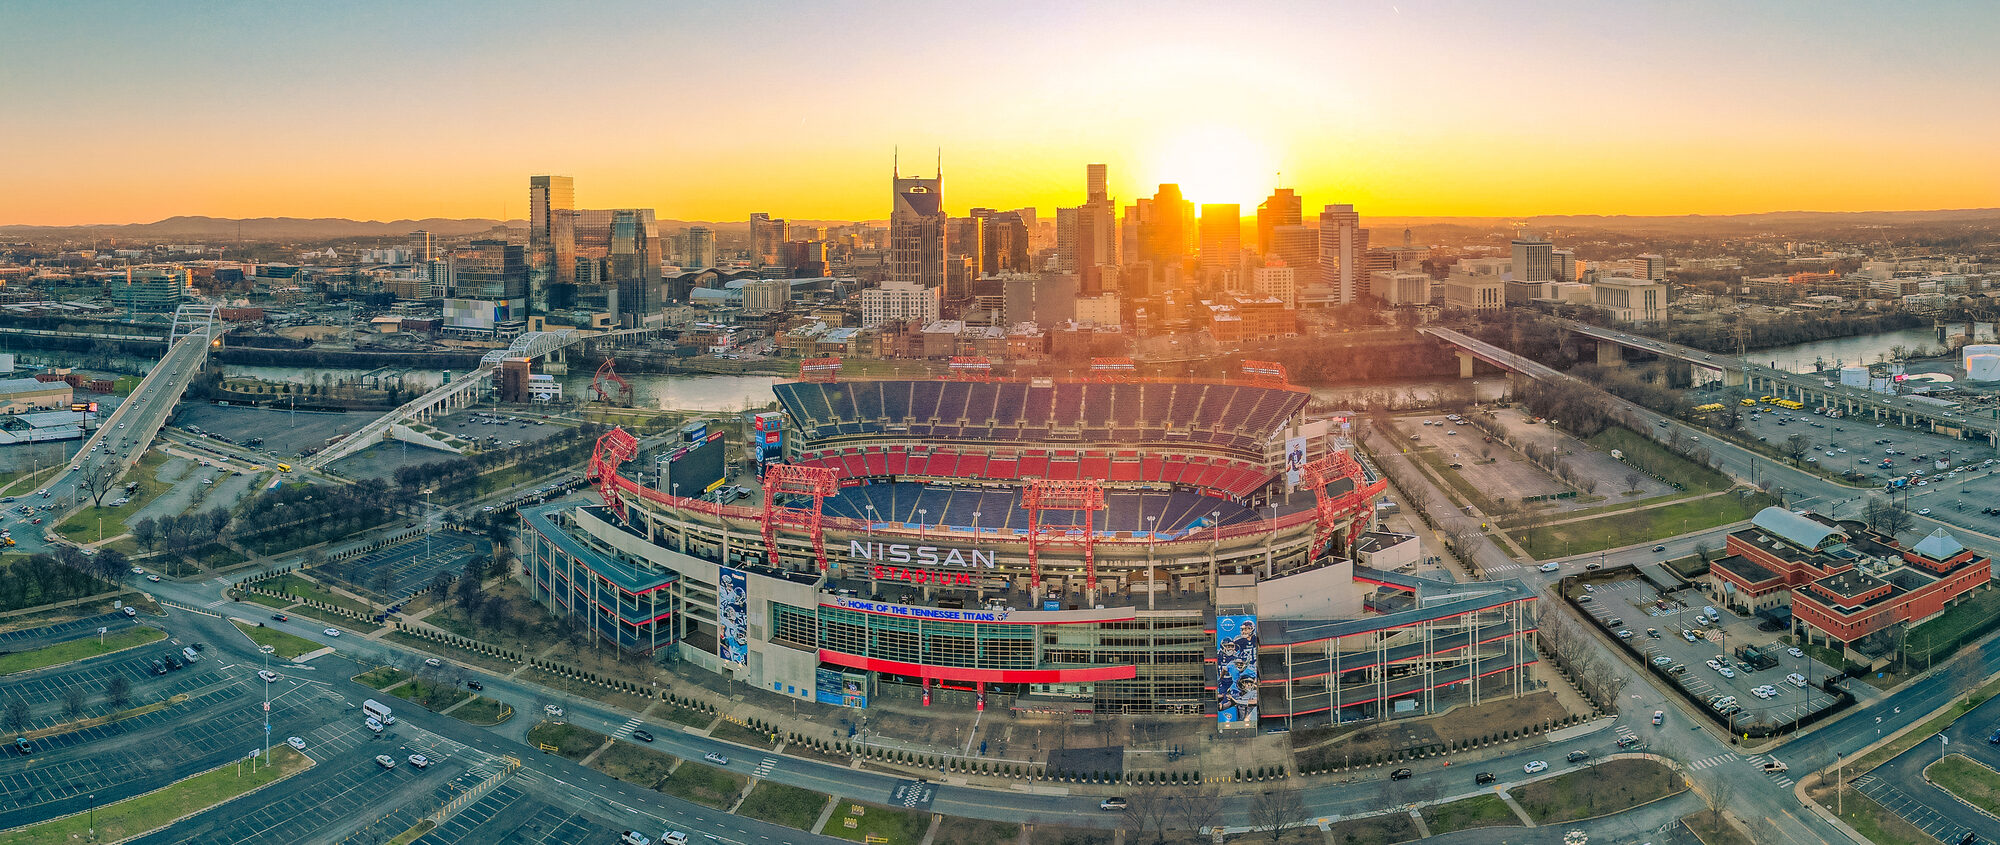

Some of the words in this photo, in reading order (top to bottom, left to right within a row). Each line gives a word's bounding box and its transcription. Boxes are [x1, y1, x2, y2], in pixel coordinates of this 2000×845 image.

[850, 540, 995, 569] NISSAN
[874, 565, 971, 585] STADIUM
[848, 600, 874, 612] HOME
[876, 603, 888, 613] OF
[891, 605, 908, 615] THE
[910, 608, 960, 620] TENNESSEE
[963, 611, 995, 621] TITANS
